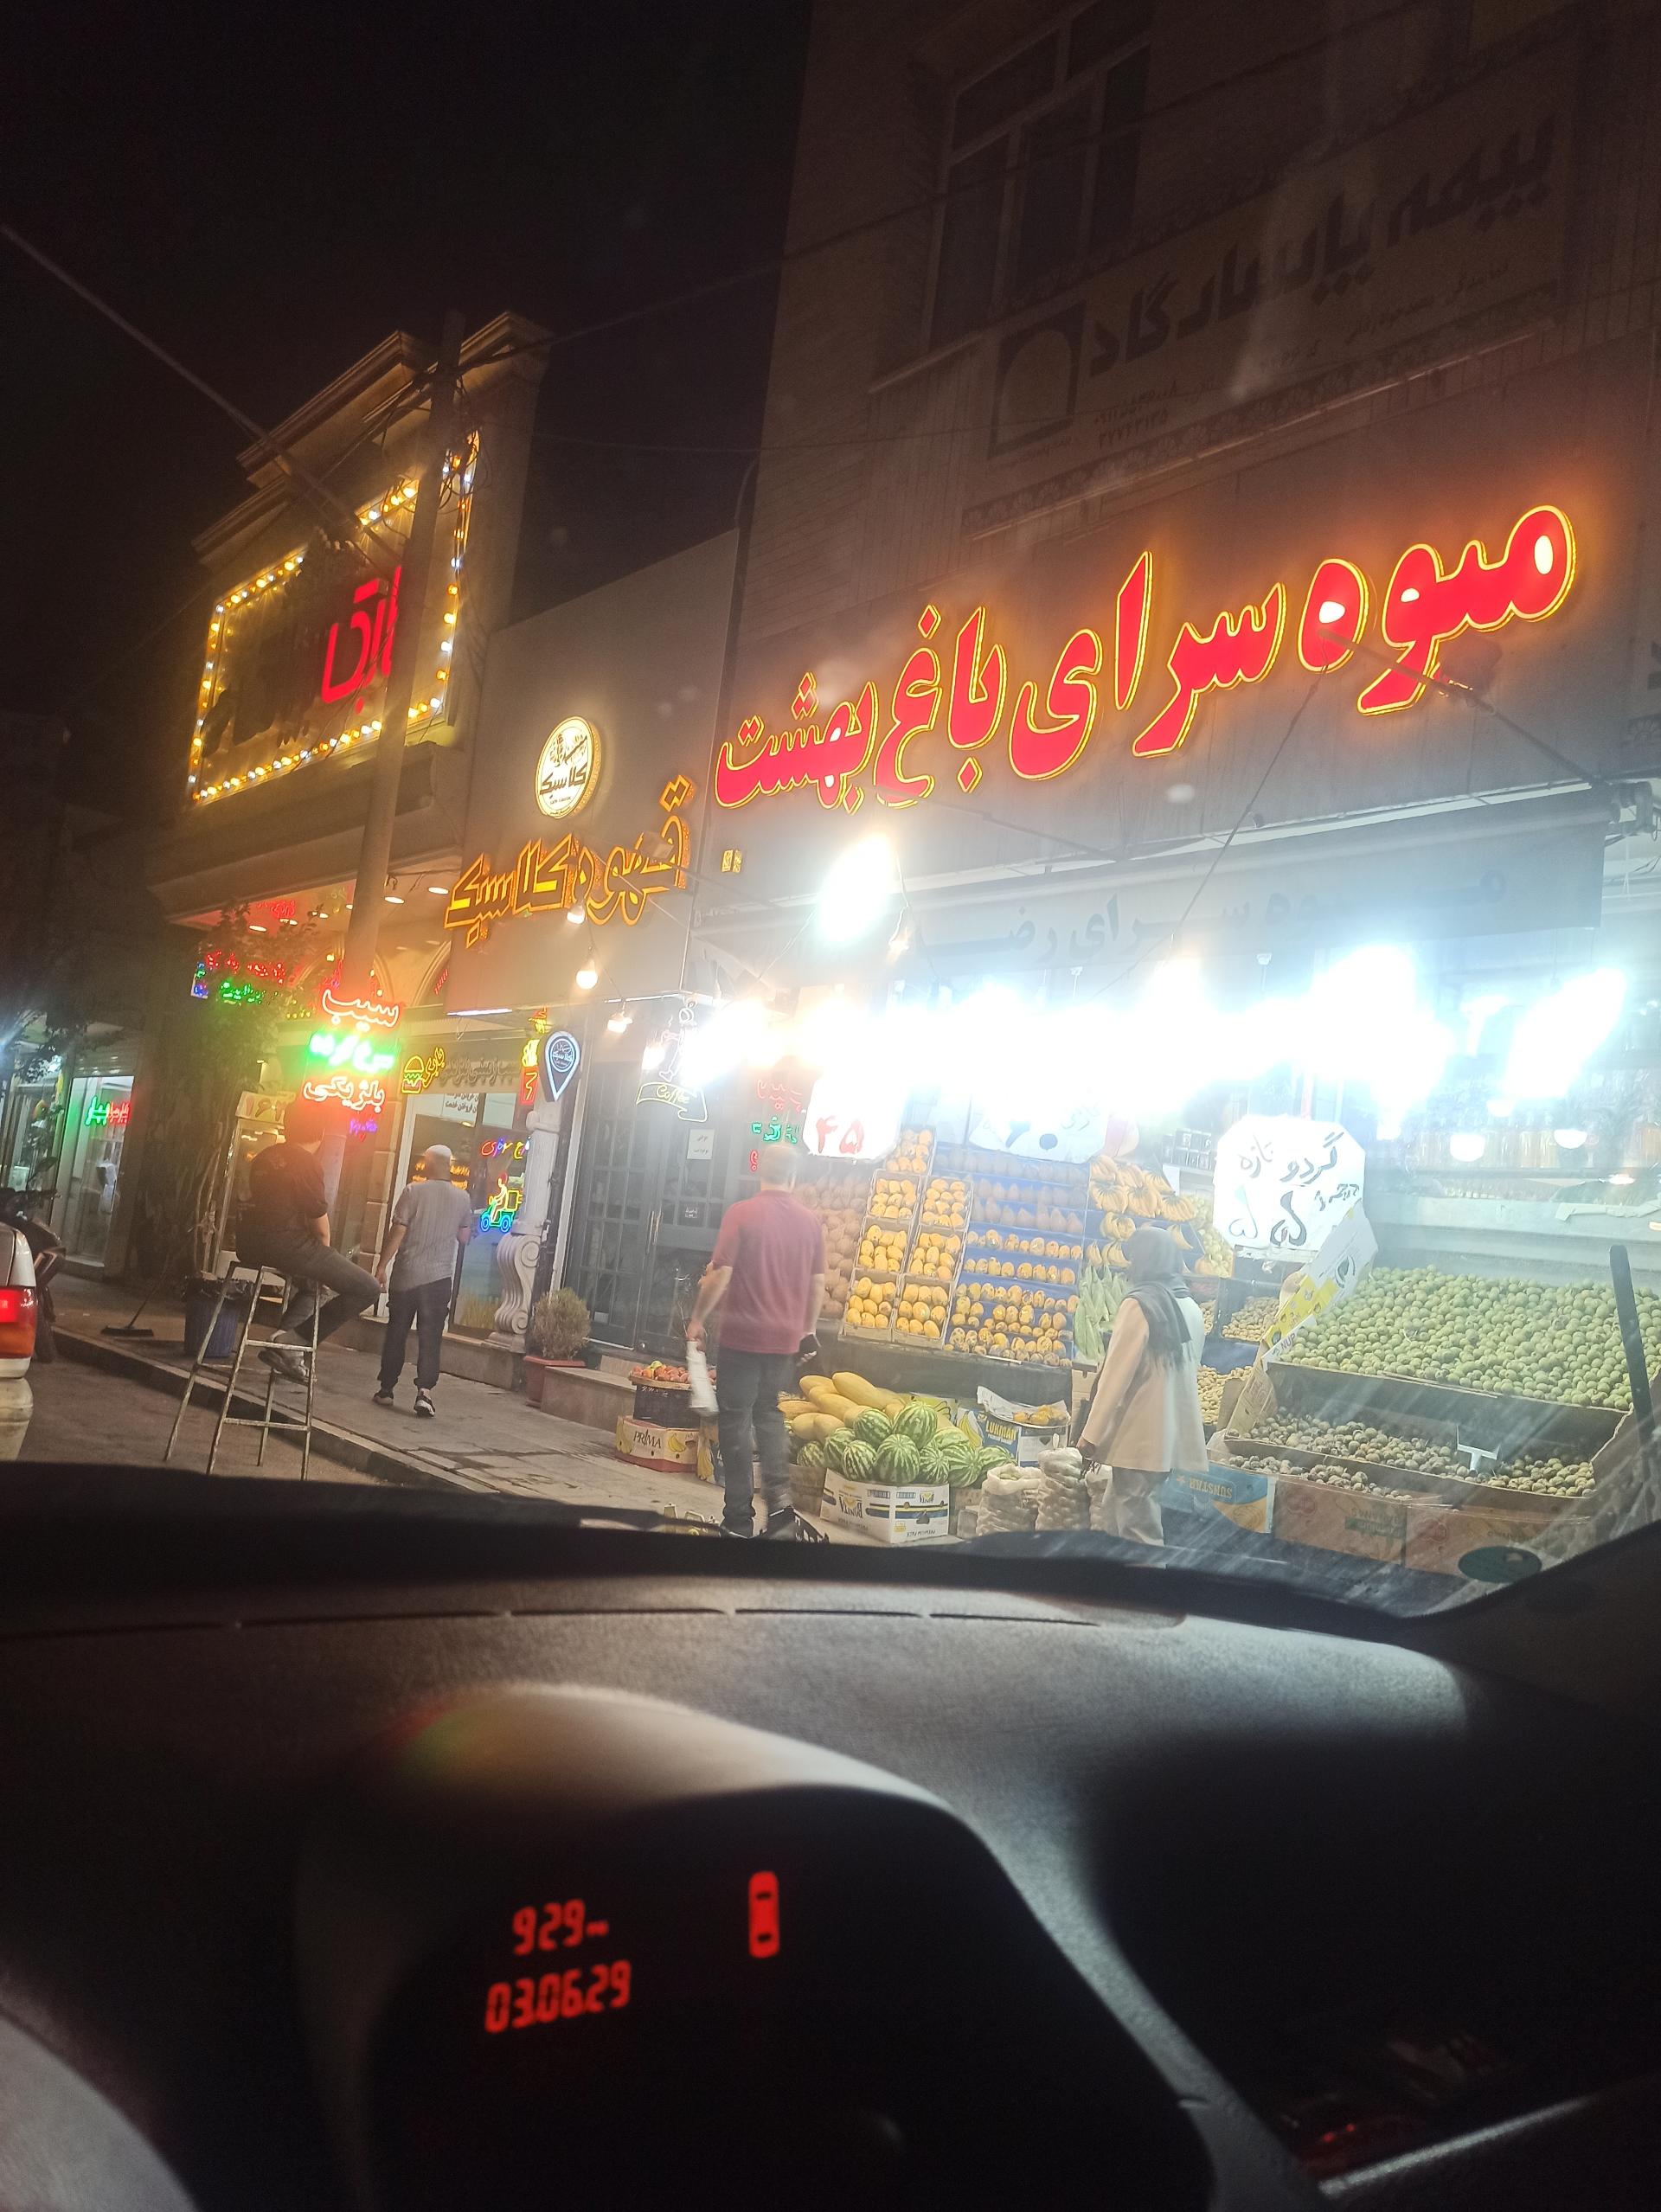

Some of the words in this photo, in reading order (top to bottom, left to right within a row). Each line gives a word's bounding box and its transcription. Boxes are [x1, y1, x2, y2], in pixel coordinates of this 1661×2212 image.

[1299, 504, 1577, 715] میوه
[1008, 551, 1286, 781] سرای
[874, 604, 1007, 809] باغ
[714, 671, 878, 814] بهشت
[539, 761, 588, 800] کلاسیک
[444, 832, 578, 949] کلاسیک
[1279, 1132, 1344, 1186] گردو
[633, 1429, 662, 1449] PRIMA
[986, 1420, 1018, 1441] LUKMAN
[838, 1496, 863, 1519] BONITA
[1190, 1477, 1233, 1499] SUNSTAR
